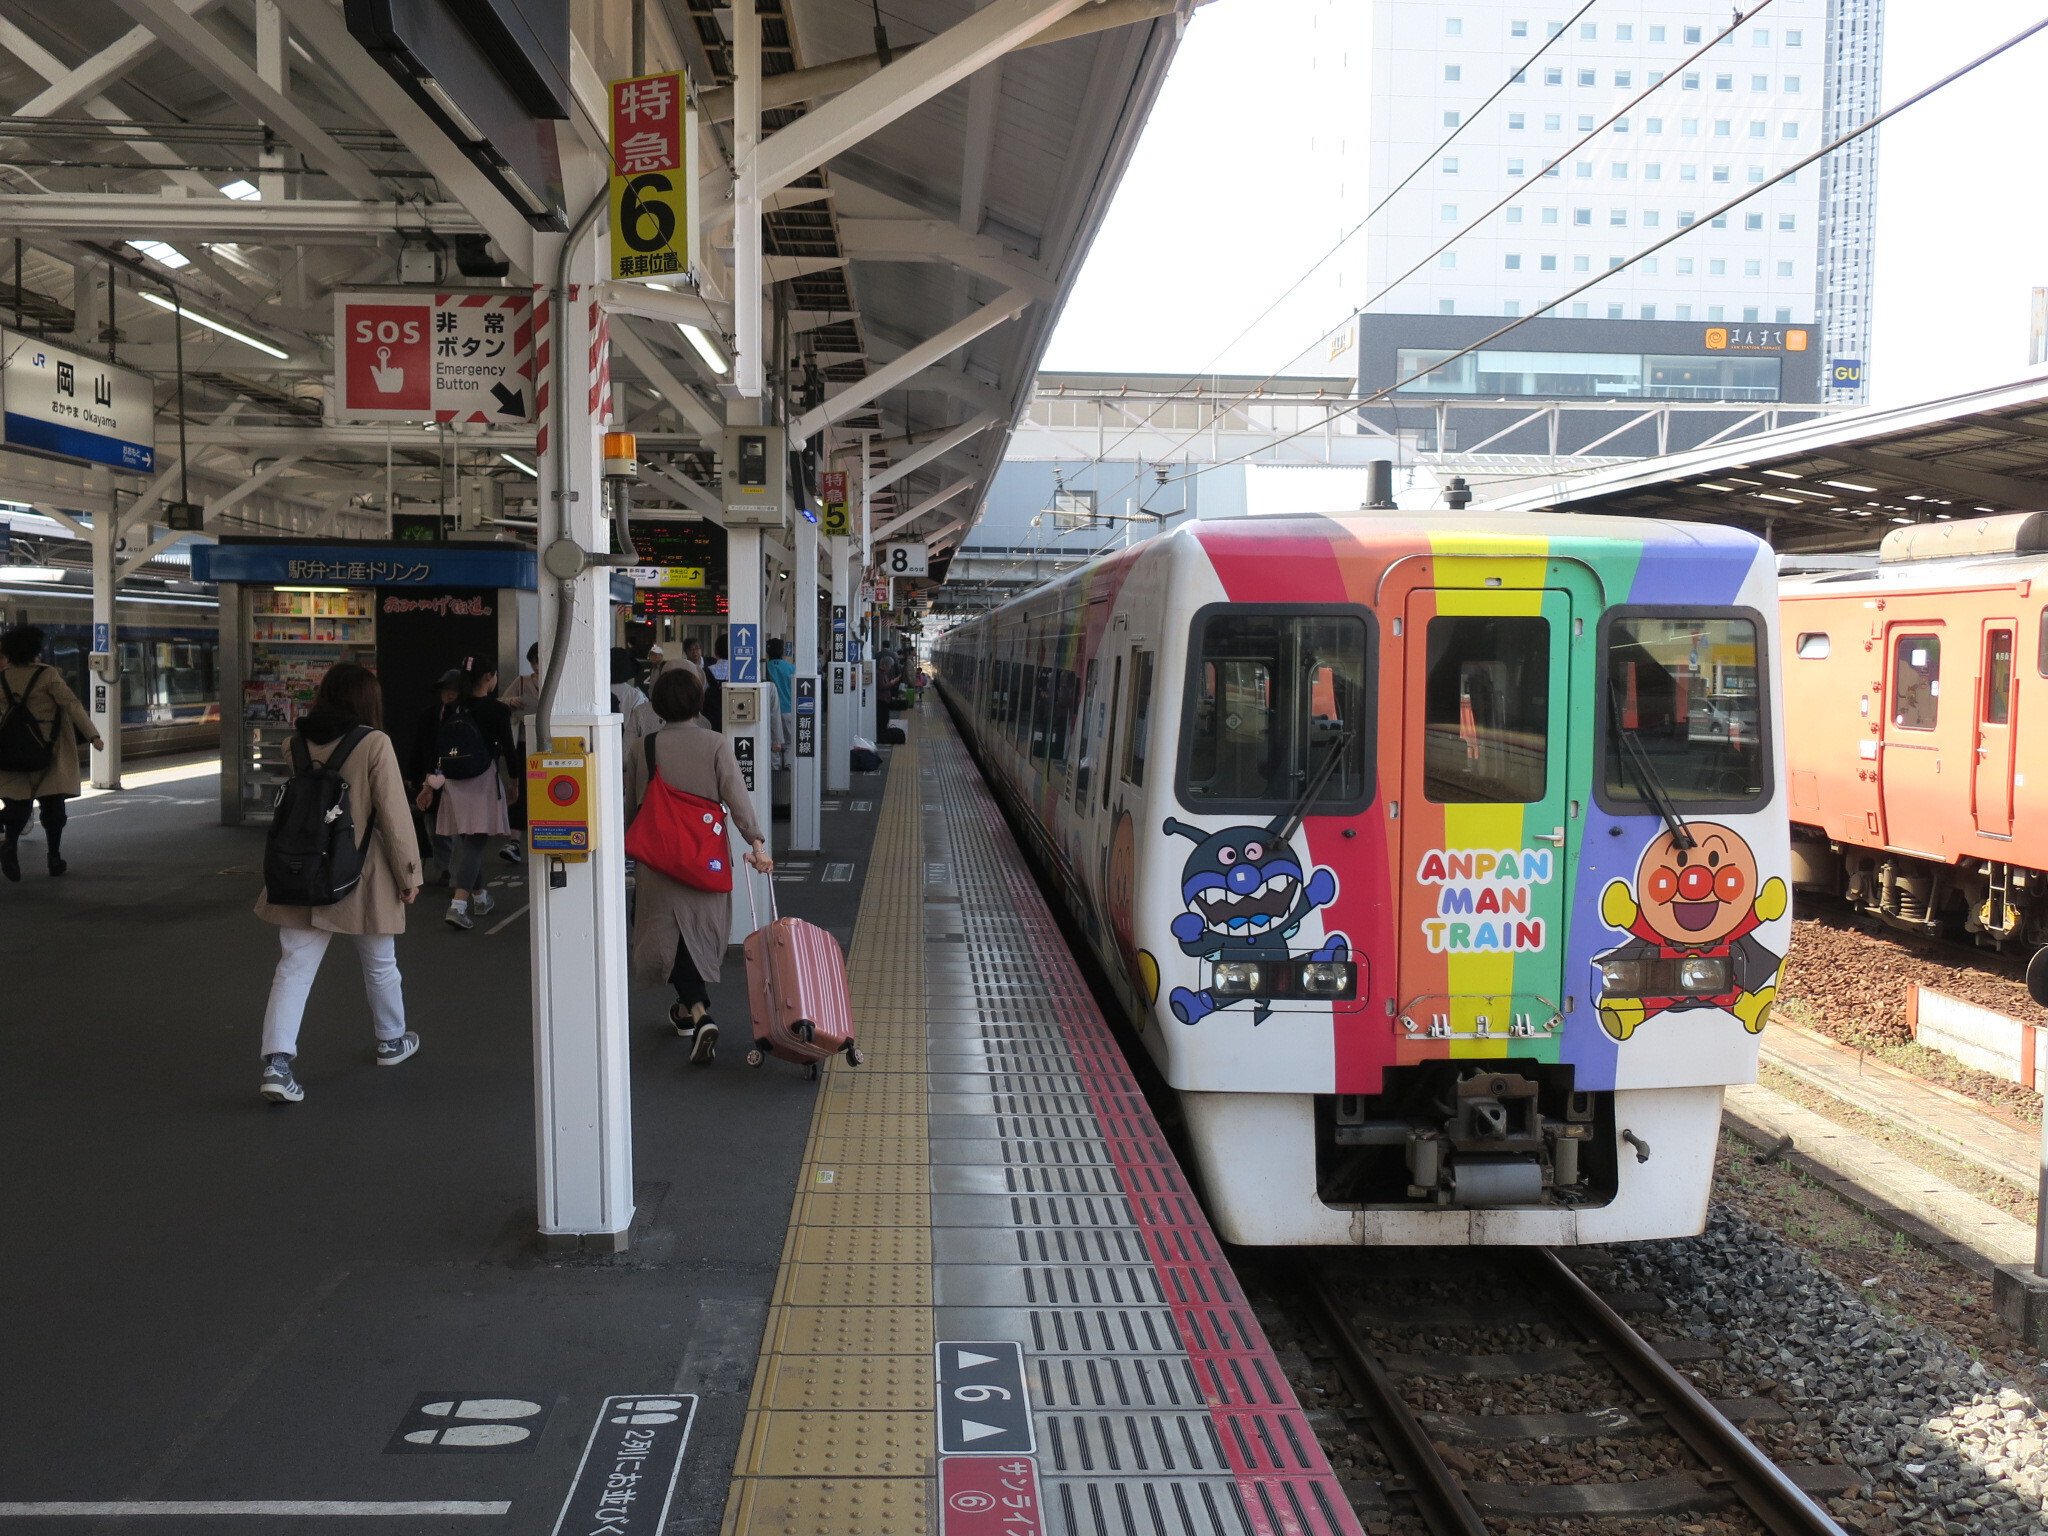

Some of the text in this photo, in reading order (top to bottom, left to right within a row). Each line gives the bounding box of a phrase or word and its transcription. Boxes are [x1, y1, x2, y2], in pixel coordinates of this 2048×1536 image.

[619, 80, 672, 172] 特急
[621, 174, 675, 252] 6
[619, 252, 681, 276] 乗車位置
[355, 320, 420, 344] SOS
[436, 312, 504, 333] 非常
[437, 337, 505, 357] ボタン
[32, 353, 45, 368] JR
[437, 363, 505, 376] Emergency
[57, 360, 111, 409] 岡山
[437, 378, 478, 390] Button
[1835, 367, 1860, 380] GU
[52, 401, 79, 418] おかやま
[83, 409, 117, 428] Okayama
[825, 473, 844, 502] 特急
[826, 503, 845, 528] 5
[288, 560, 431, 581] 駅弁・土産・ドリンク
[892, 548, 908, 572] 8
[98, 639, 106, 651] 7
[834, 633, 844, 660] 新幹線
[850, 653, 857, 661] 7
[735, 656, 752, 680] 7
[799, 717, 811, 753] 新幹線
[529, 760, 539, 770] W
[1421, 853, 1549, 880] ANPAN
[1441, 887, 1527, 914] MAN
[1426, 921, 1541, 949] TRAIN
[954, 1384, 1012, 1402] 6
